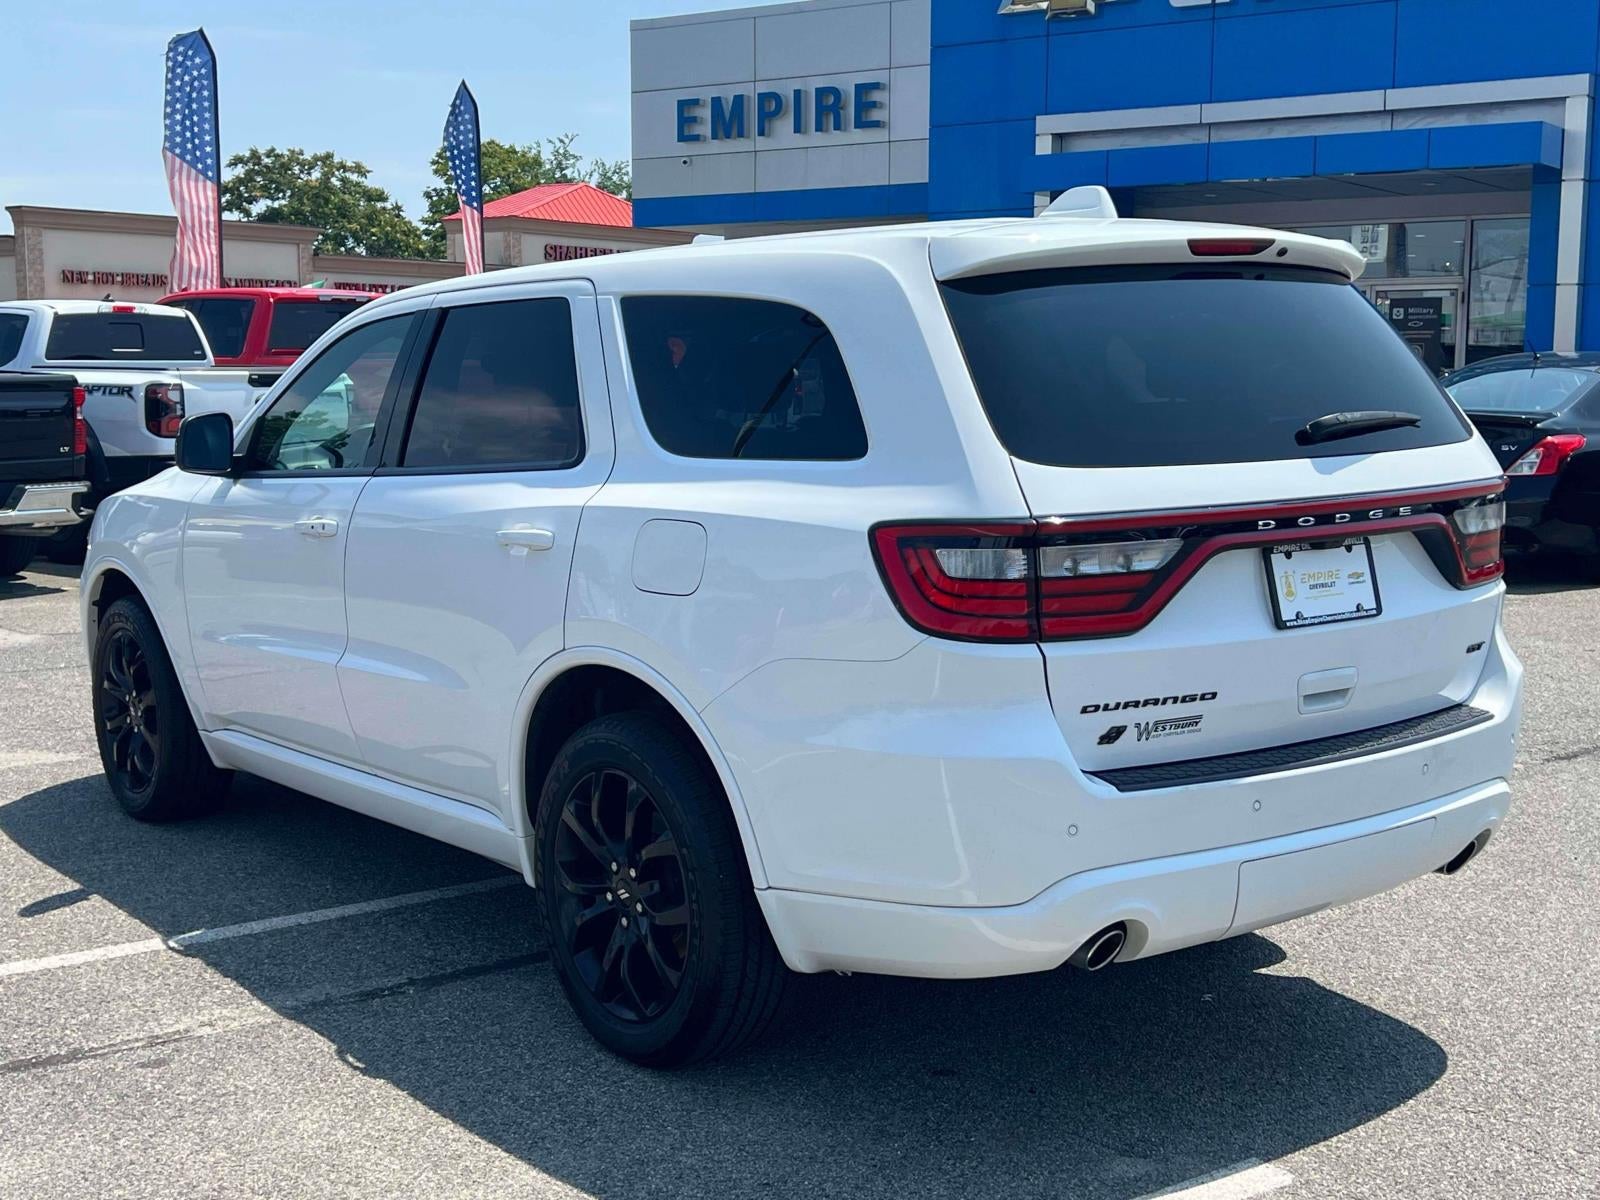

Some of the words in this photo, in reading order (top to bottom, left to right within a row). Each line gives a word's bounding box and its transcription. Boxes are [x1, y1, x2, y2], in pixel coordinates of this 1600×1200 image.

[676, 82, 888, 143] EMPIRE
[62, 269, 88, 284] NEW
[1407, 307, 1434, 315] Military
[84, 385, 137, 403] APTOR
[1257, 506, 1412, 530] DODGE
[1273, 543, 1300, 553] EMPIRE
[1301, 569, 1341, 584] EMPIRE
[1080, 691, 1218, 714] DURANGO
